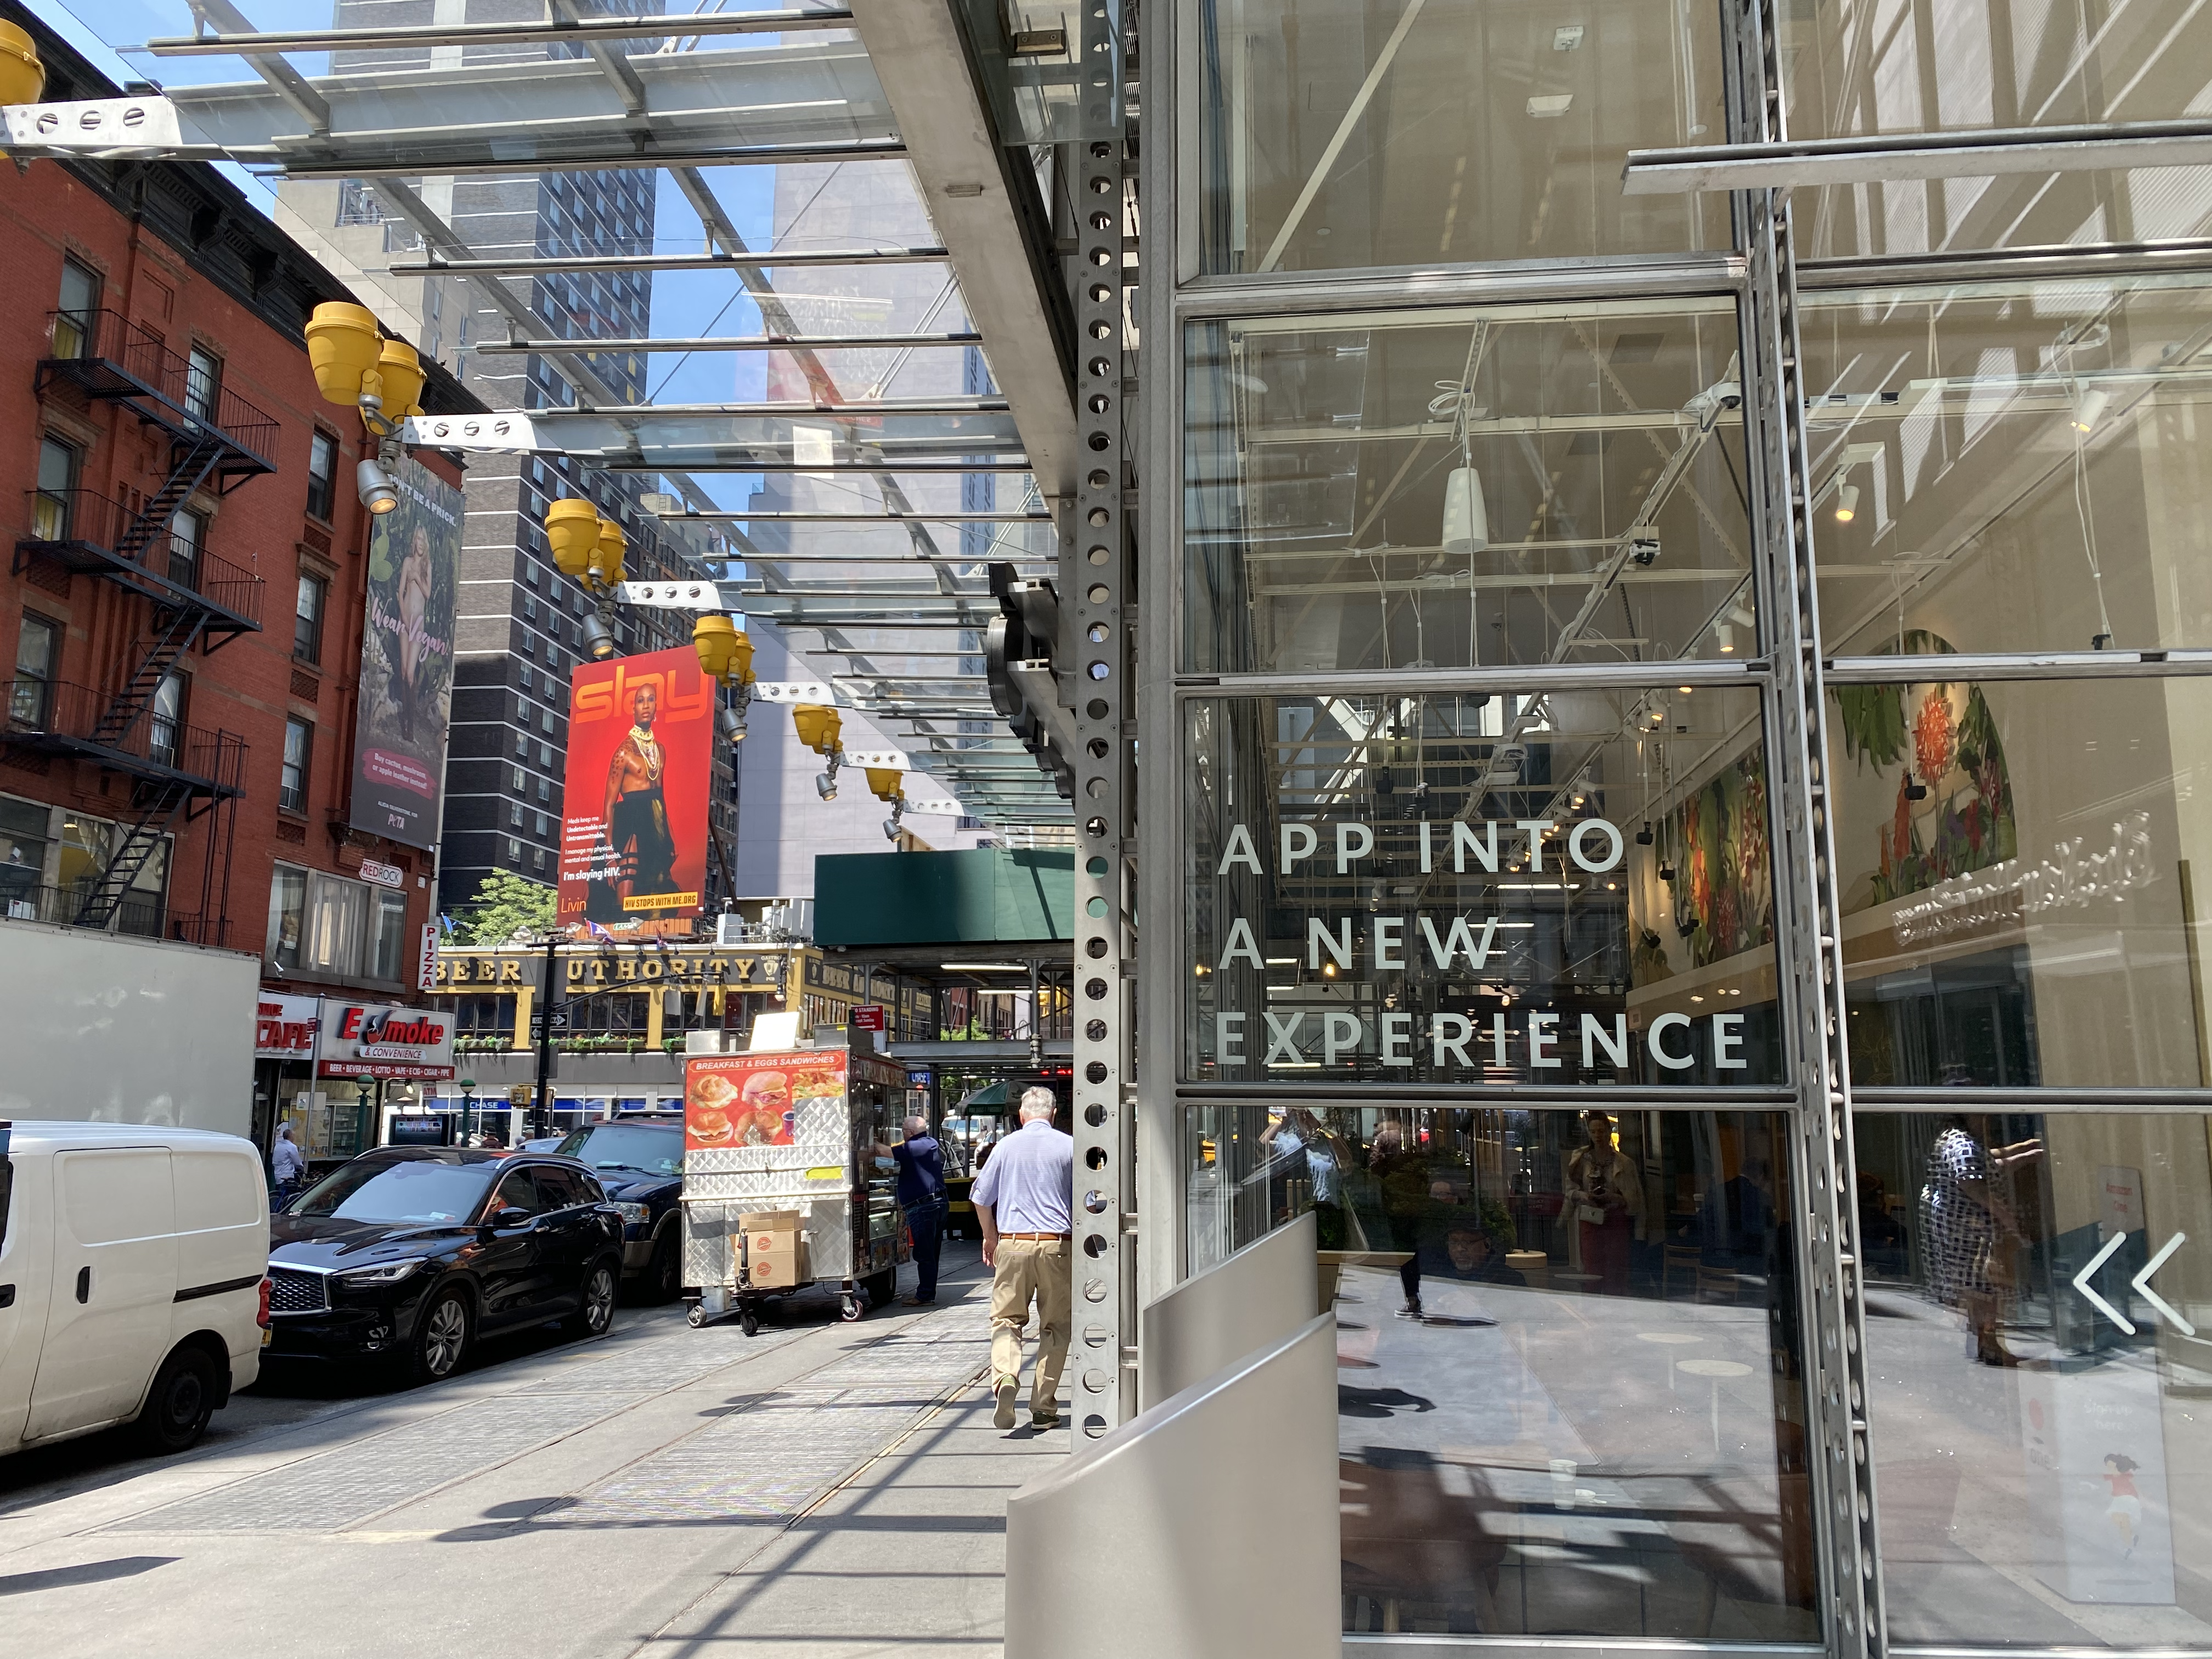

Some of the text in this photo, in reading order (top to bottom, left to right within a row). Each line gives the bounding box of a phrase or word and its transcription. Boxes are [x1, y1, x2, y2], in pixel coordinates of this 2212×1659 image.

[413, 489, 424, 505] BE
[425, 499, 430, 510] A
[431, 502, 456, 527] PRICK.
[371, 597, 449, 663] Wear Vegan.
[575, 665, 709, 724] slay
[375, 753, 427, 780] Buy cactus, mushroom,
[379, 767, 392, 776] apple
[393, 771, 409, 783] leather
[410, 777, 427, 789] instead!
[566, 832, 606, 842] Untransmittable.
[567, 824, 598, 833] Undetectable
[594, 844, 614, 853] physical,
[1218, 818, 1624, 874] APP INTO
[363, 864, 400, 883] REDROCK
[563, 867, 620, 882] I'm slaying HIV.
[561, 895, 696, 913] Livin HIV STOPS WITH ME.ORG
[1219, 916, 1499, 970] A NEW
[422, 927, 436, 987] PIZZA
[436, 958, 755, 981] BEER UTHORITY
[822, 964, 850, 990] BEER
[256, 1020, 313, 1049] CAFE
[340, 1008, 364, 1039] E
[1217, 1012, 1747, 1069] EXPERIENCE
[365, 1047, 422, 1059] & CONVENIENCE
[696, 1060, 746, 1070] BREAKFAST
[780, 1056, 834, 1065] SANDWICHES
[330, 1063, 342, 1073] BEER
[346, 1064, 372, 1074] BEVERAGE
[375, 1066, 391, 1074] LOTTO
[911, 1072, 927, 1083] CHASE
[424, 1087, 437, 1096] ATM
